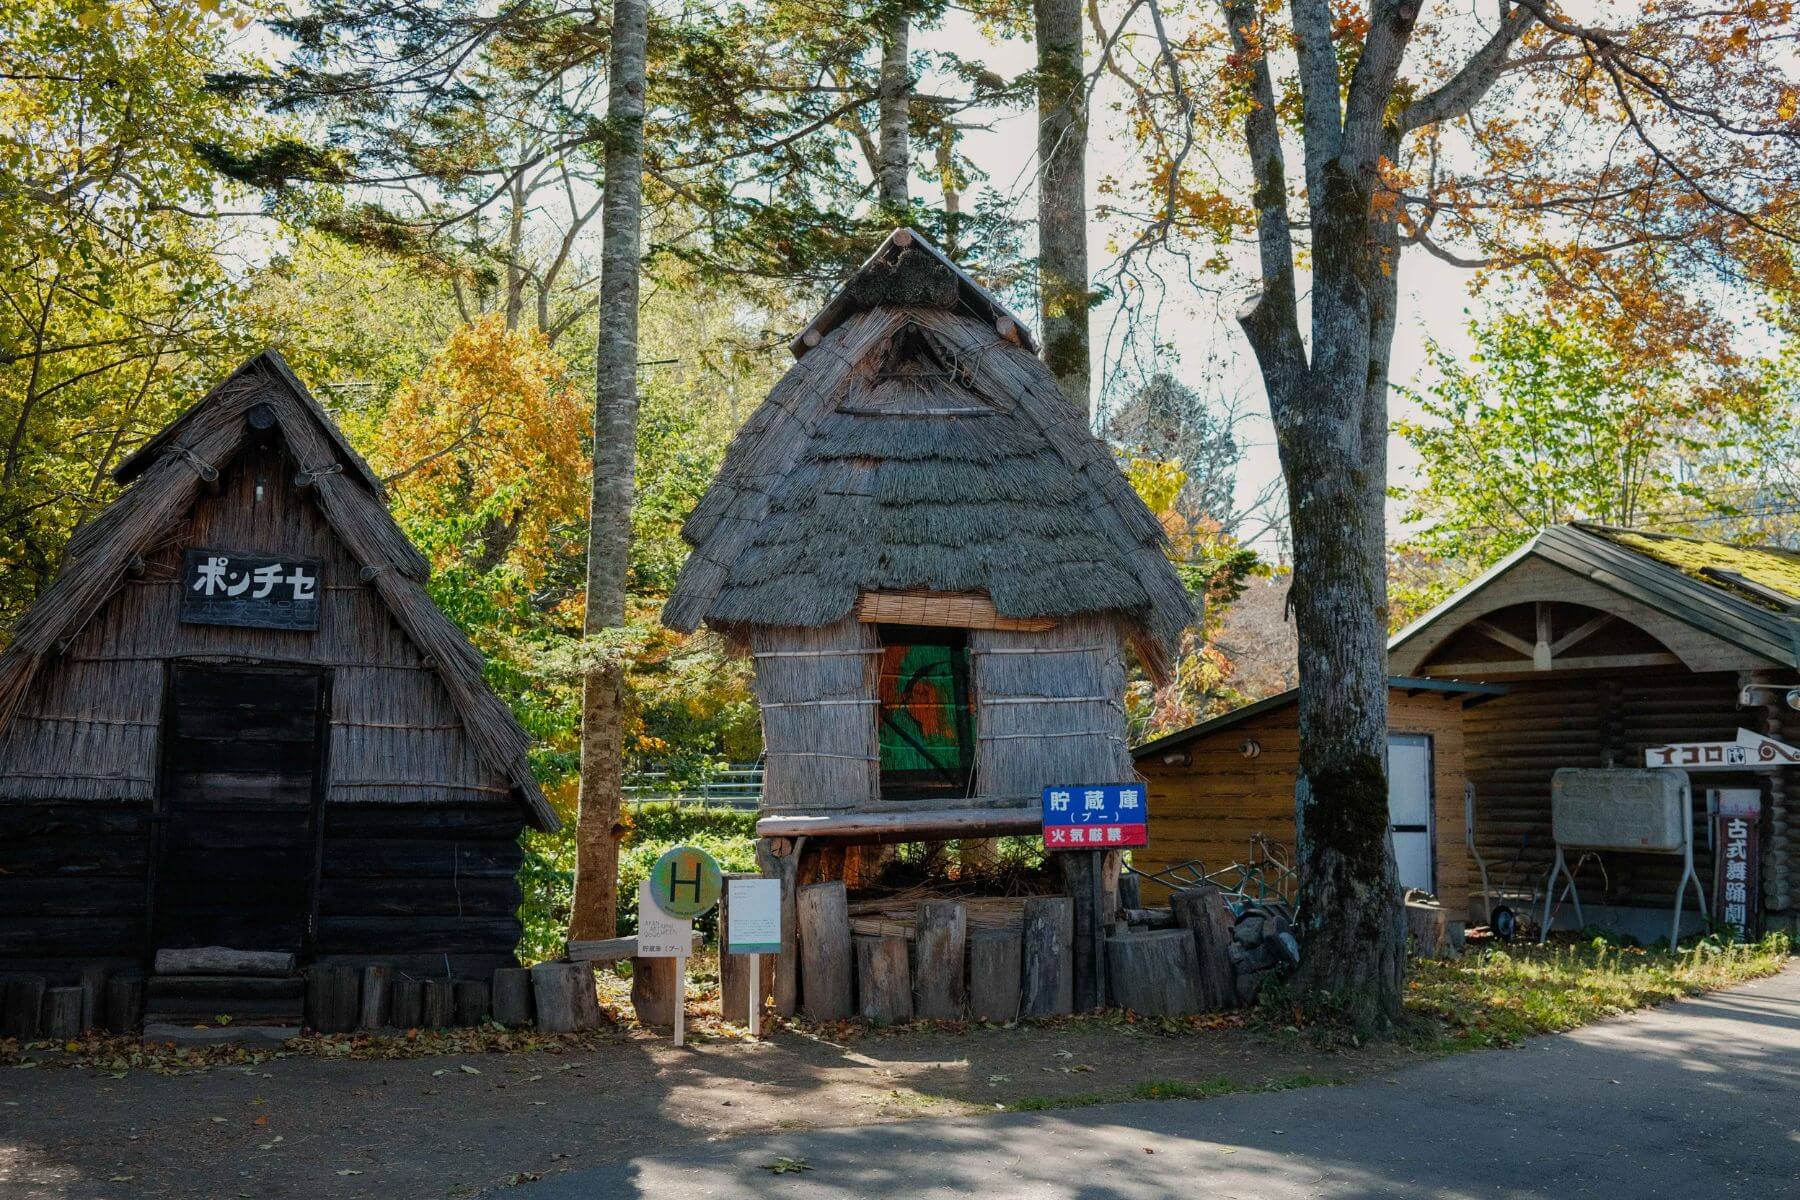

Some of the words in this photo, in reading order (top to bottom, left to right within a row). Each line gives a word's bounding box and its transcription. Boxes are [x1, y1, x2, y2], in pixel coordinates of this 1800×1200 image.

[193, 557, 315, 600] ポンチセ
[1654, 746, 1723, 765] イコロ
[1050, 789, 1139, 811] 貯蔵庫
[1070, 811, 1119, 823] (プー)
[1051, 827, 1122, 842] 火気厳禁
[670, 862, 702, 903] H
